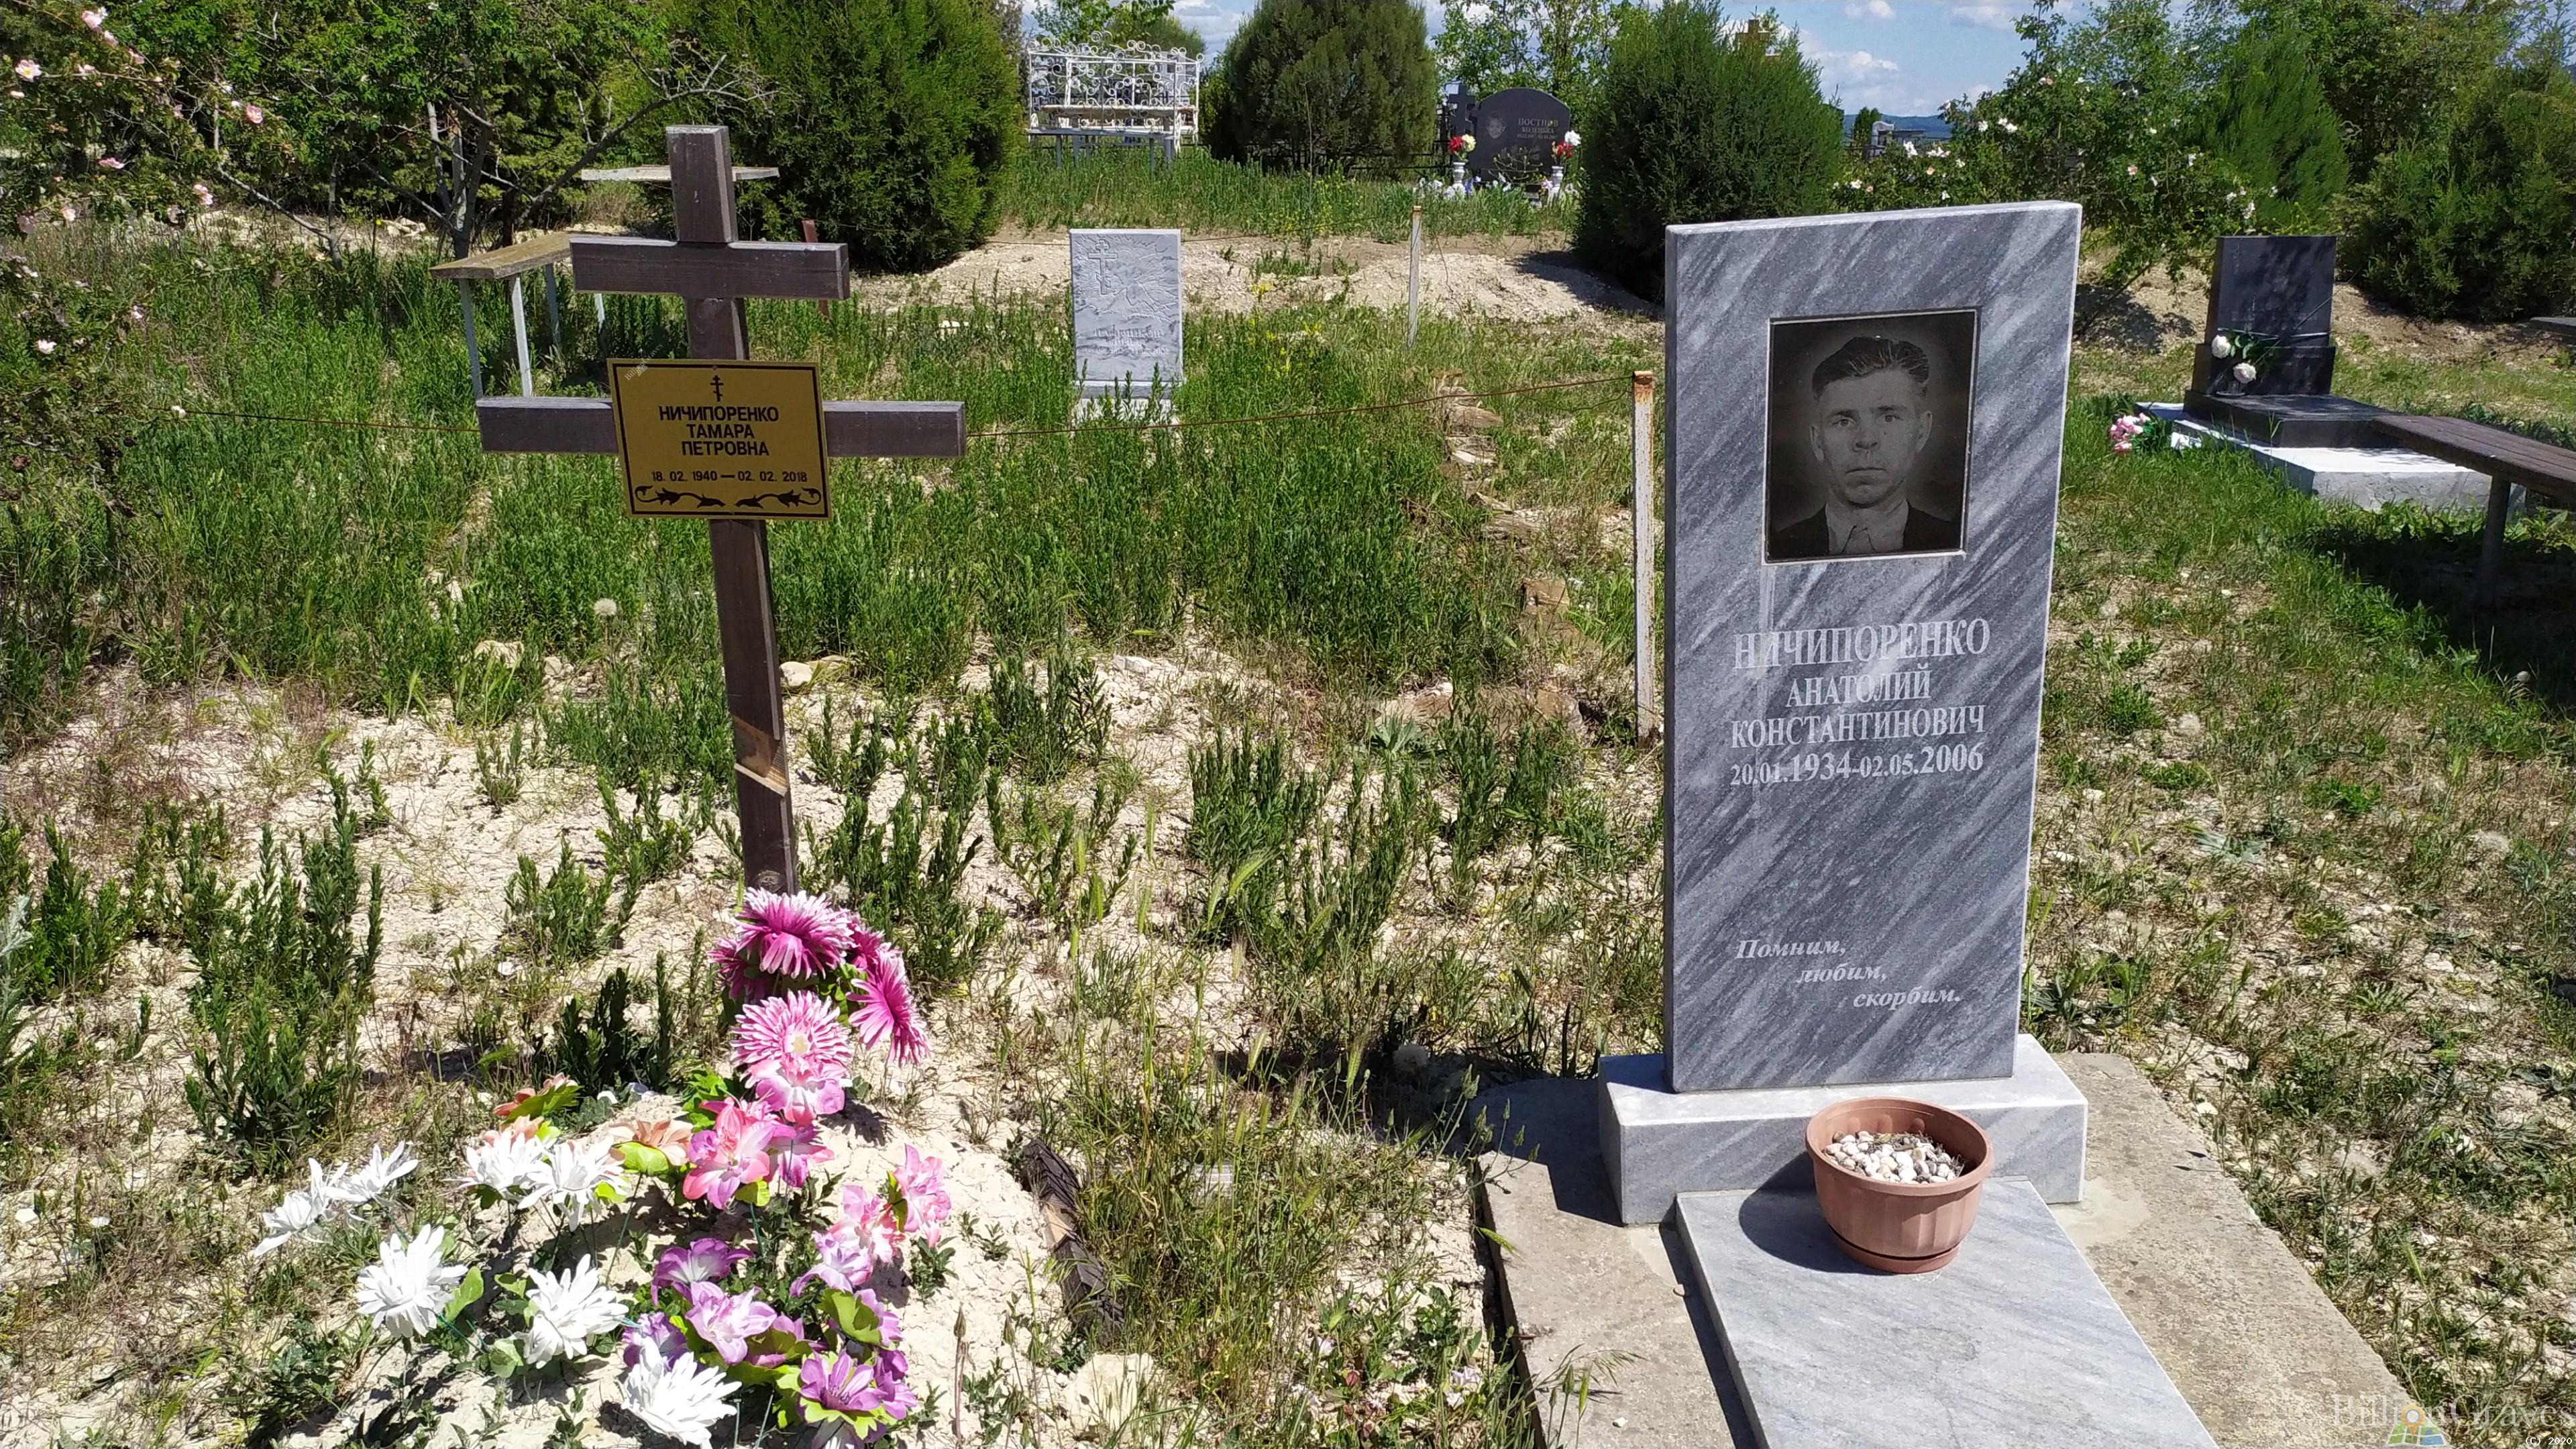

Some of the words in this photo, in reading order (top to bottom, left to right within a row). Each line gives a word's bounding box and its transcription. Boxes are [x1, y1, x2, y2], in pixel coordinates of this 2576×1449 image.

[659, 406, 779, 422] НИЧИПОРЕНКО
[686, 423, 755, 438] ТАМАРА
[681, 441, 769, 456] ПЕТРОВНА
[1733, 619, 1991, 669] НИЧИПОРЕНКО
[1785, 663, 1933, 707] АНАТОЛИЙ
[1730, 705, 1986, 748] КОНСТАНТИНОВИЧ
[1735, 939, 1847, 959] Помним,
[1796, 962, 1888, 985] любим,
[1853, 985, 1962, 1010] скорбим.
